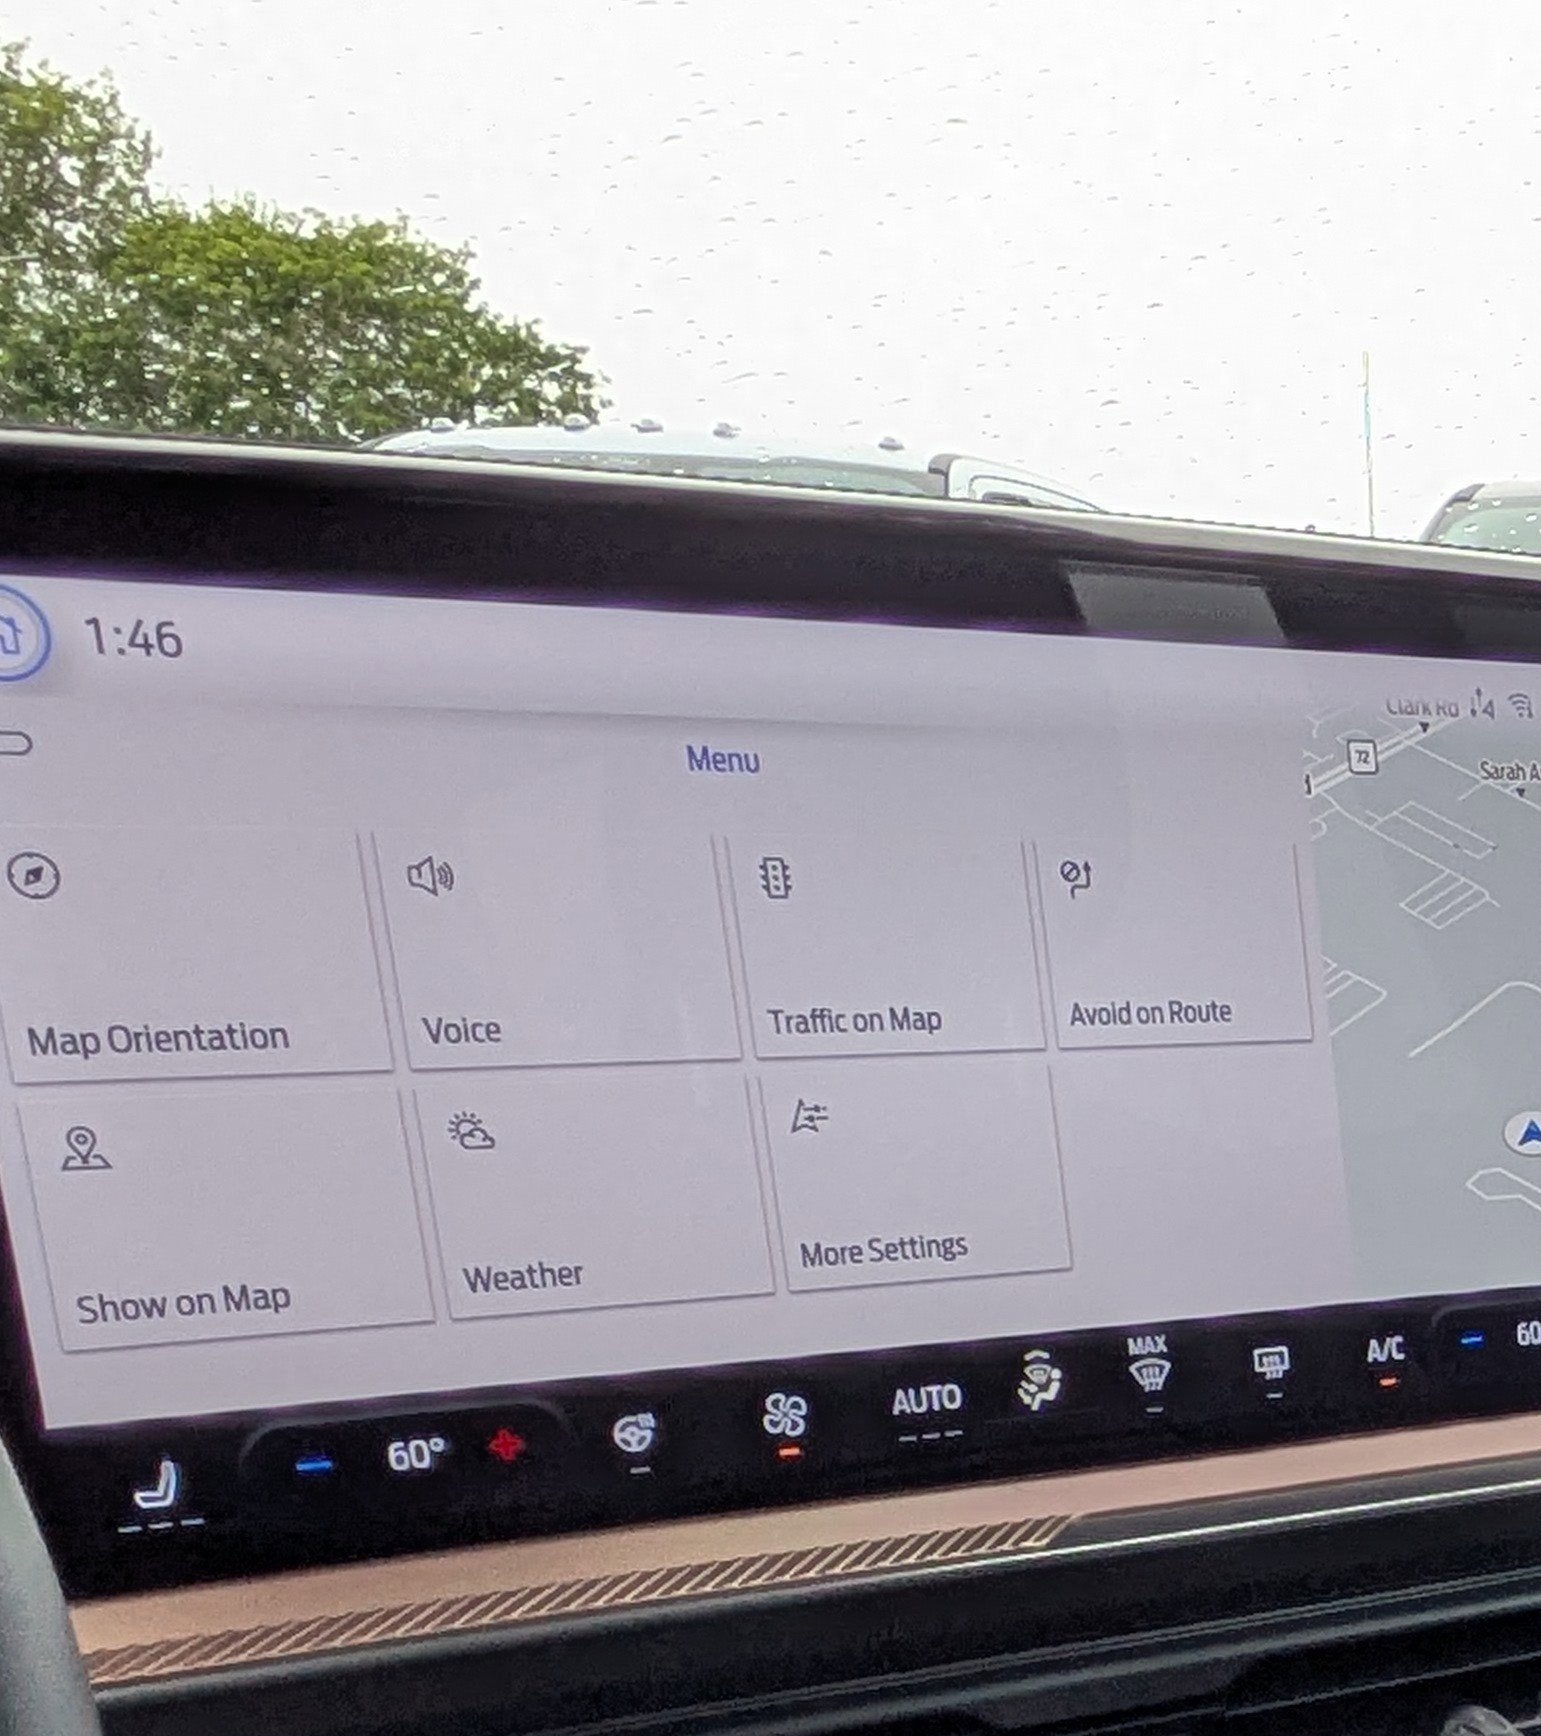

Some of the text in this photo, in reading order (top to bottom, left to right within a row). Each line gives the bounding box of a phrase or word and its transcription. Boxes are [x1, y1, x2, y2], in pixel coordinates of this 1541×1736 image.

[84, 615, 184, 659] 1:46
[686, 743, 761, 775] Menu
[1480, 761, 1526, 782] Sarah
[768, 1005, 942, 1037] Traffic on Map
[1070, 998, 1232, 1028] Avoid on Route
[27, 1020, 290, 1059] Map Orientation
[421, 1016, 502, 1047] Voice
[800, 1229, 969, 1267] More Settings
[463, 1260, 585, 1295] Weather
[77, 1283, 292, 1325] Show on Map
[1127, 1334, 1168, 1355] MAX
[1367, 1335, 1405, 1363] A/C
[891, 1384, 962, 1413] AUTO
[388, 1436, 447, 1473] 60°
